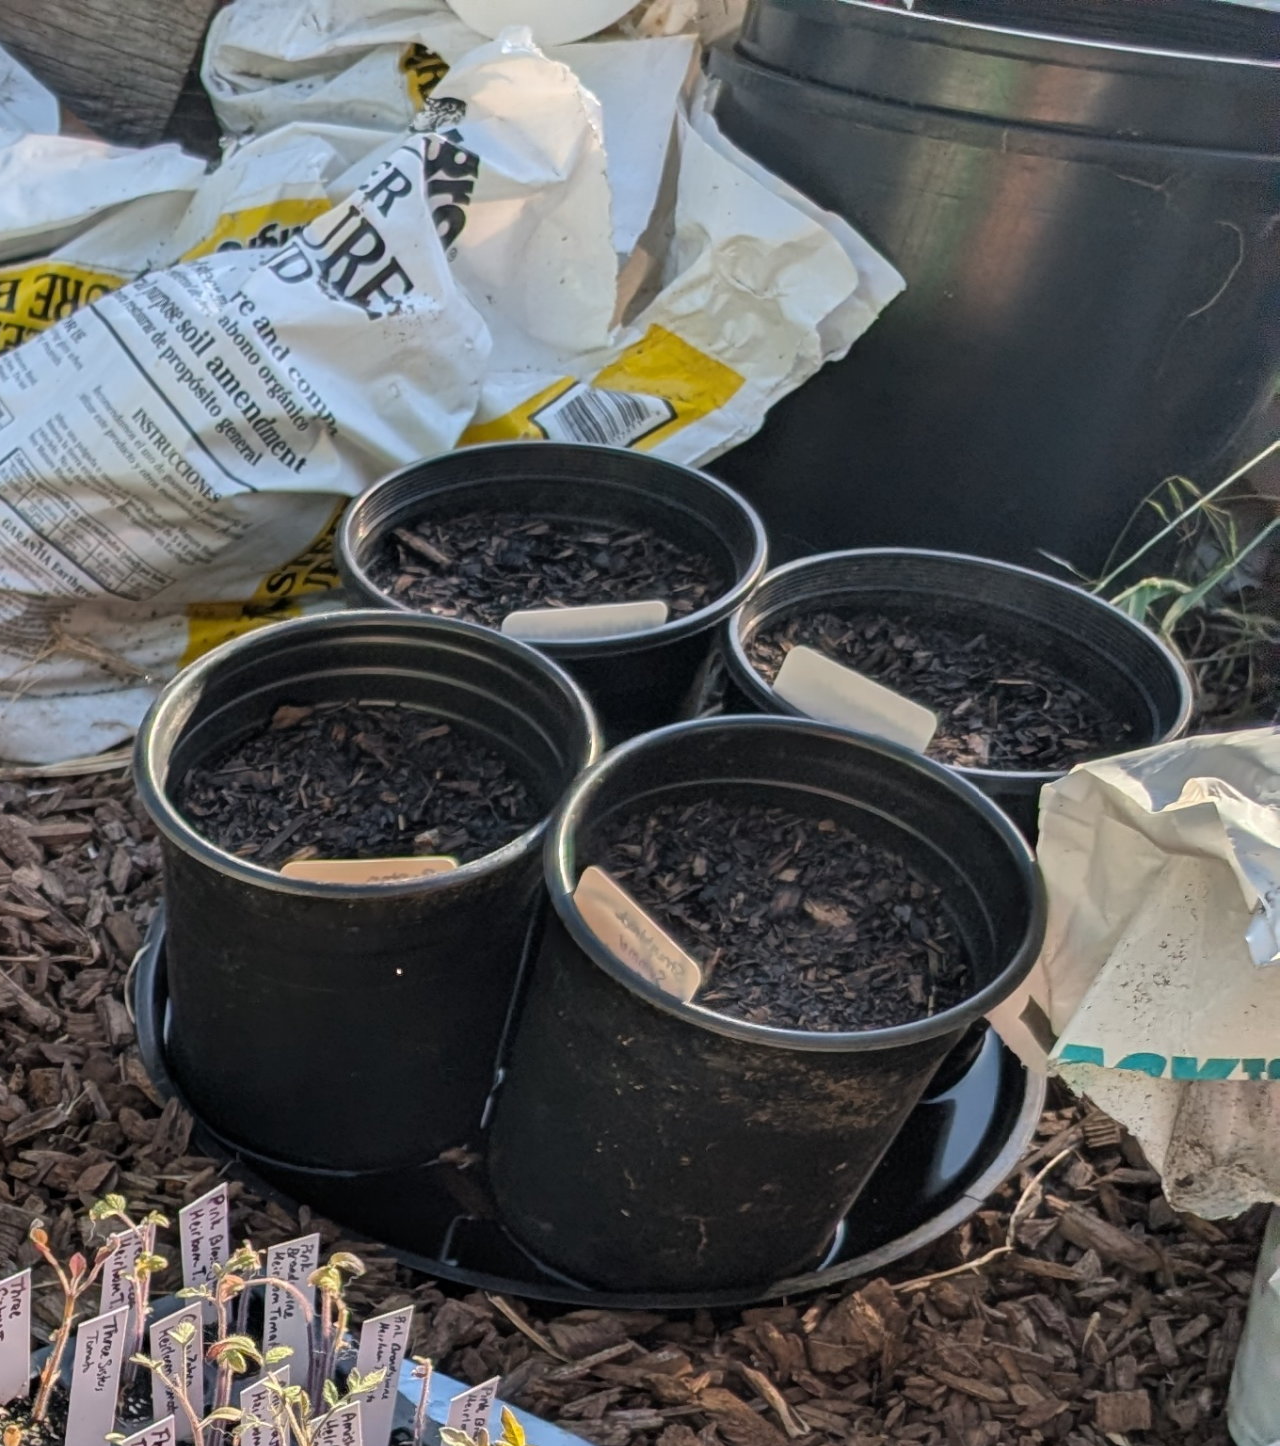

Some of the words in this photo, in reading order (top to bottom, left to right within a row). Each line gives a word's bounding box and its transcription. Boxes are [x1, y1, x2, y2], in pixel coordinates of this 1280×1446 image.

[217, 314, 261, 366] abono
[258, 365, 309, 432] orgánico
[253, 316, 291, 363] and
[151, 330, 167, 350] de
[159, 345, 223, 418] propósito
[215, 416, 264, 467] general
[176, 318, 216, 359] soil
[206, 355, 308, 474] amendment
[131, 407, 223, 504] INSTRUCCIONES
[207, 1193, 227, 1233] Pink
[8, 1276, 27, 1320] Three
[102, 1315, 119, 1359] Three
